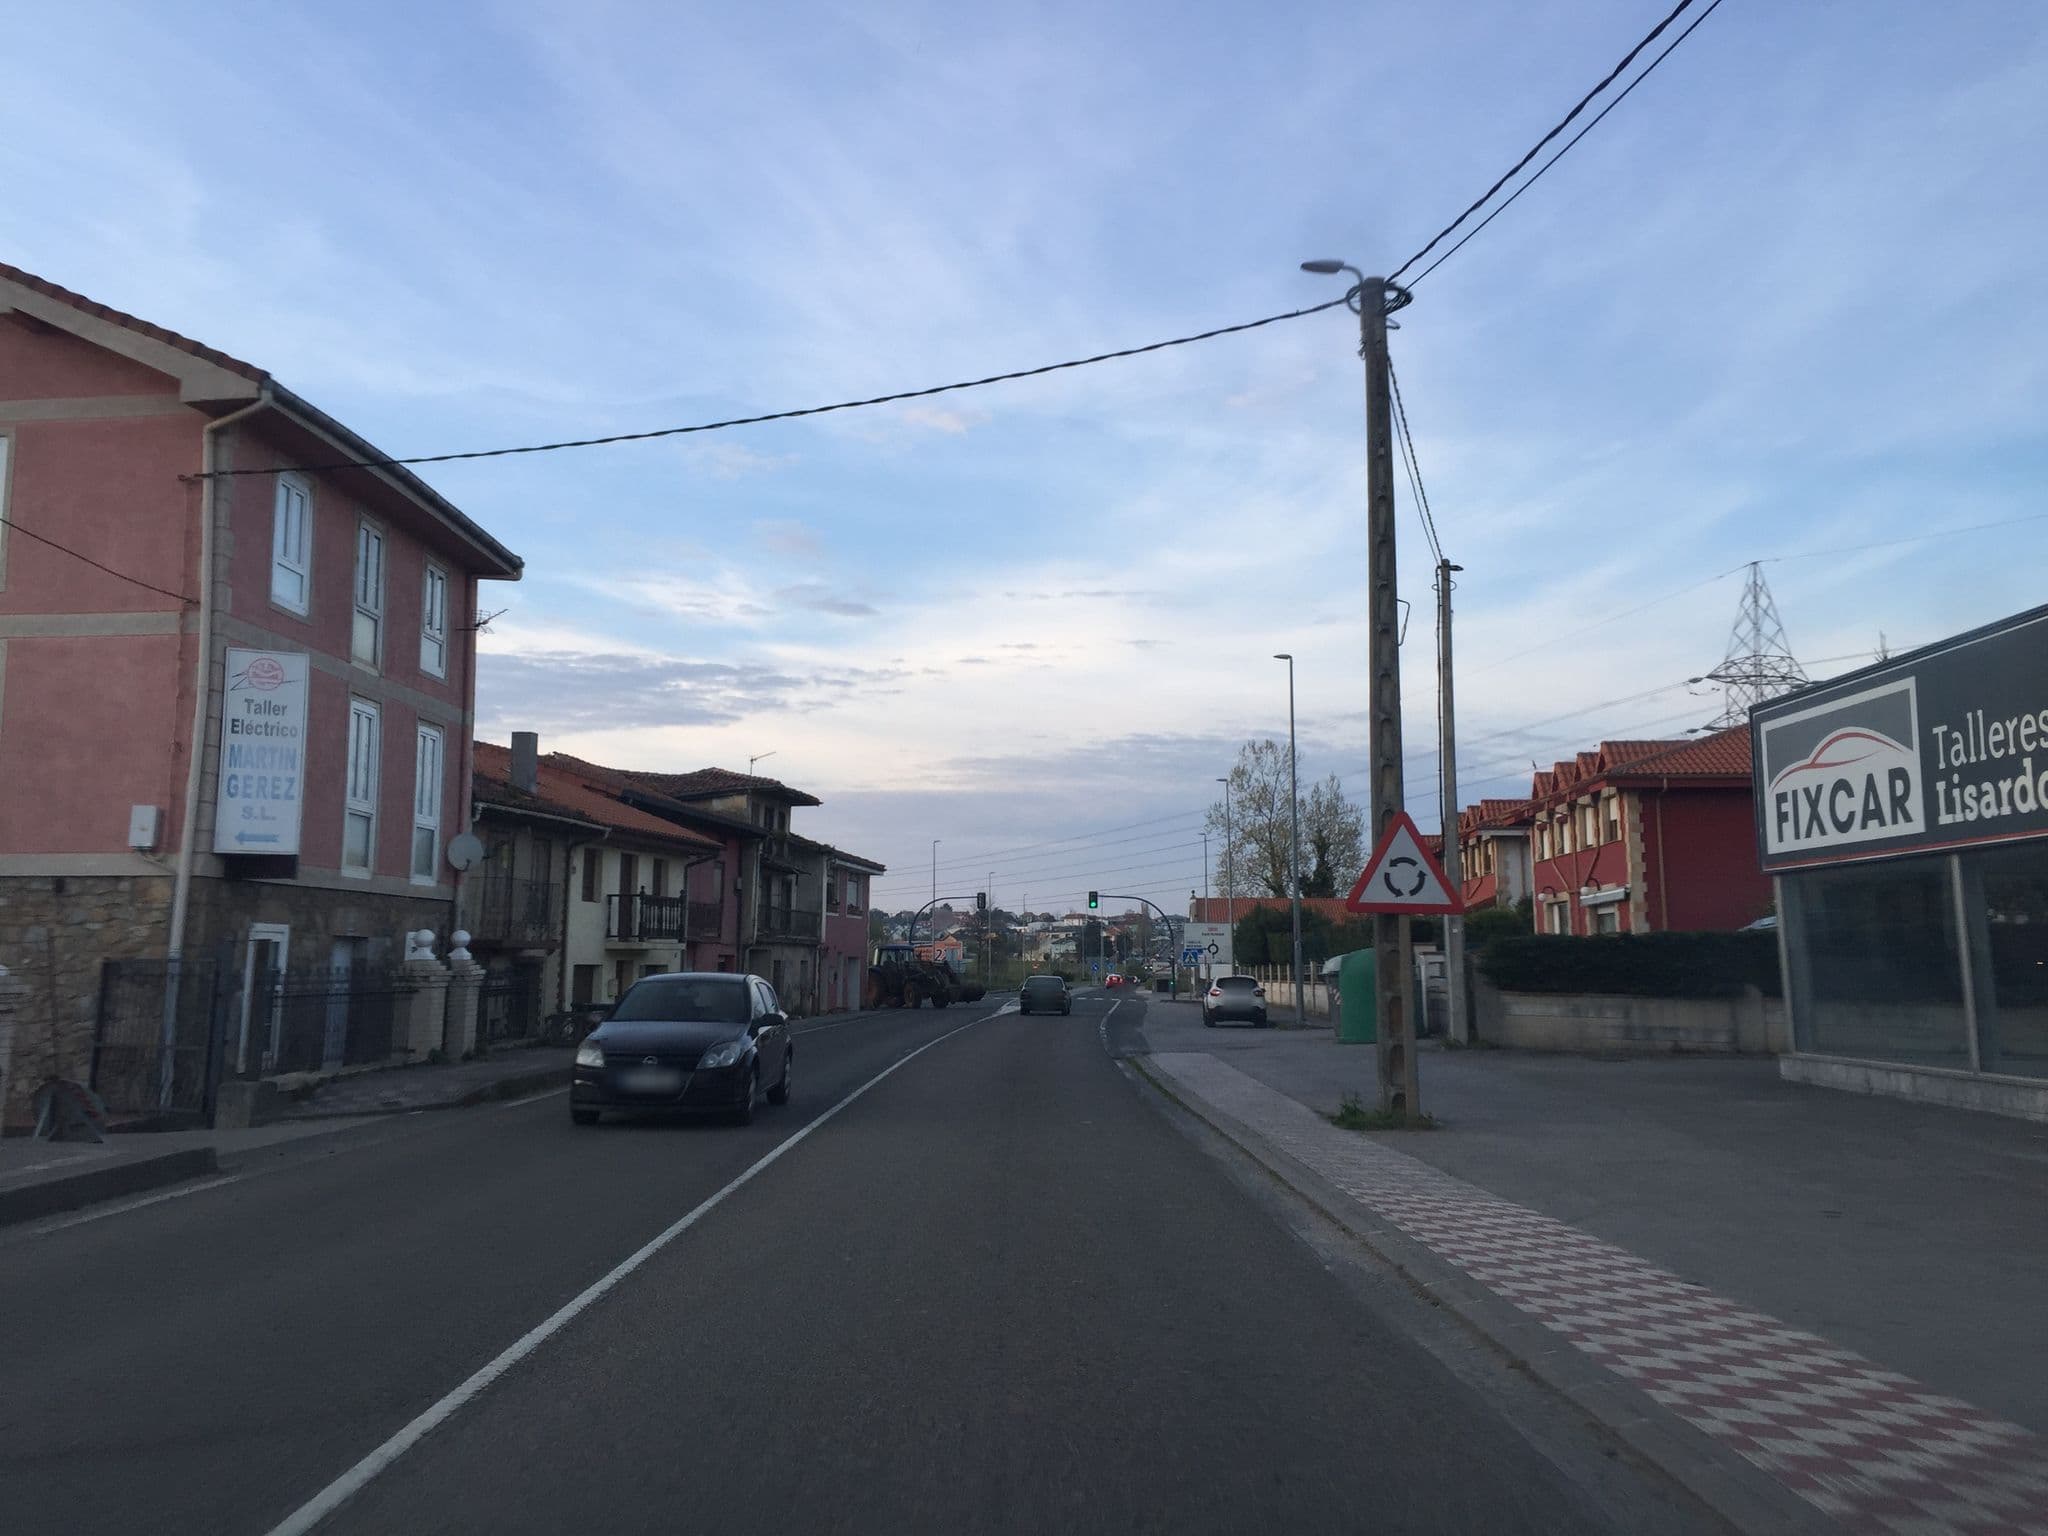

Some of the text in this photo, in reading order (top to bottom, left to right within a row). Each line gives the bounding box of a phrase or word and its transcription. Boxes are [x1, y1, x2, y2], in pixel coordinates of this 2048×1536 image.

[244, 698, 288, 716] Taller
[231, 718, 298, 738] Eléctrico
[1933, 709, 2048, 770] Talleres
[226, 774, 296, 800] GEREZ
[241, 806, 276, 821] S.L.
[1775, 766, 1914, 843] FIXCAR
